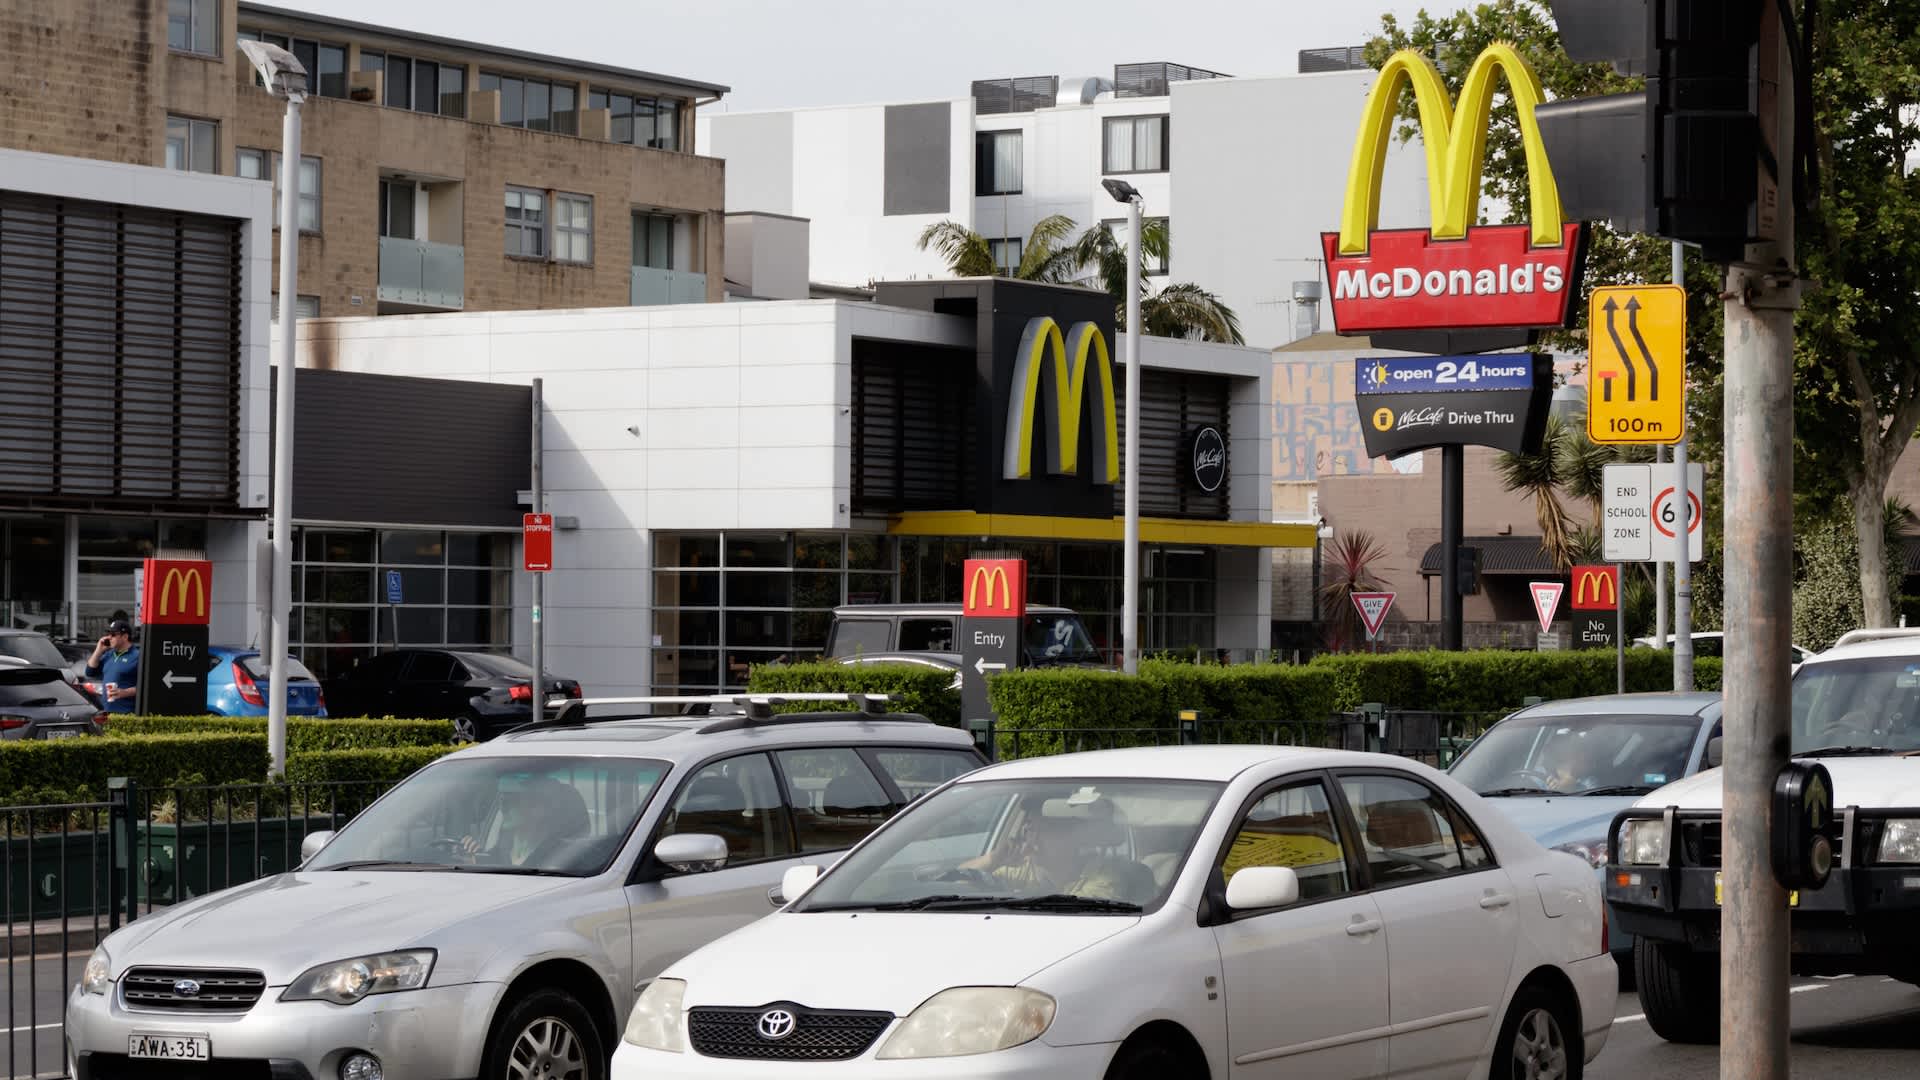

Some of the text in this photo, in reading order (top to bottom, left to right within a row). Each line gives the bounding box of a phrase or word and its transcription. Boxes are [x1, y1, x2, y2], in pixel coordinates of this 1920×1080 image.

[1335, 262, 1564, 299] McDonald's
[1393, 361, 1526, 383] open 24 hours
[1448, 412, 1482, 424] Drive
[1484, 410, 1514, 424] Thru
[1609, 418, 1662, 433] 100 m
[1616, 487, 1638, 497] END
[1607, 507, 1648, 518] SCHOOL
[1662, 502, 1692, 523] 6
[1613, 528, 1641, 538] ZONE
[1364, 600, 1383, 608] GIVE
[1588, 620, 1605, 631] No
[974, 631, 1005, 648] Entry
[1582, 631, 1611, 644] Entry
[162, 640, 196, 660] Entry
